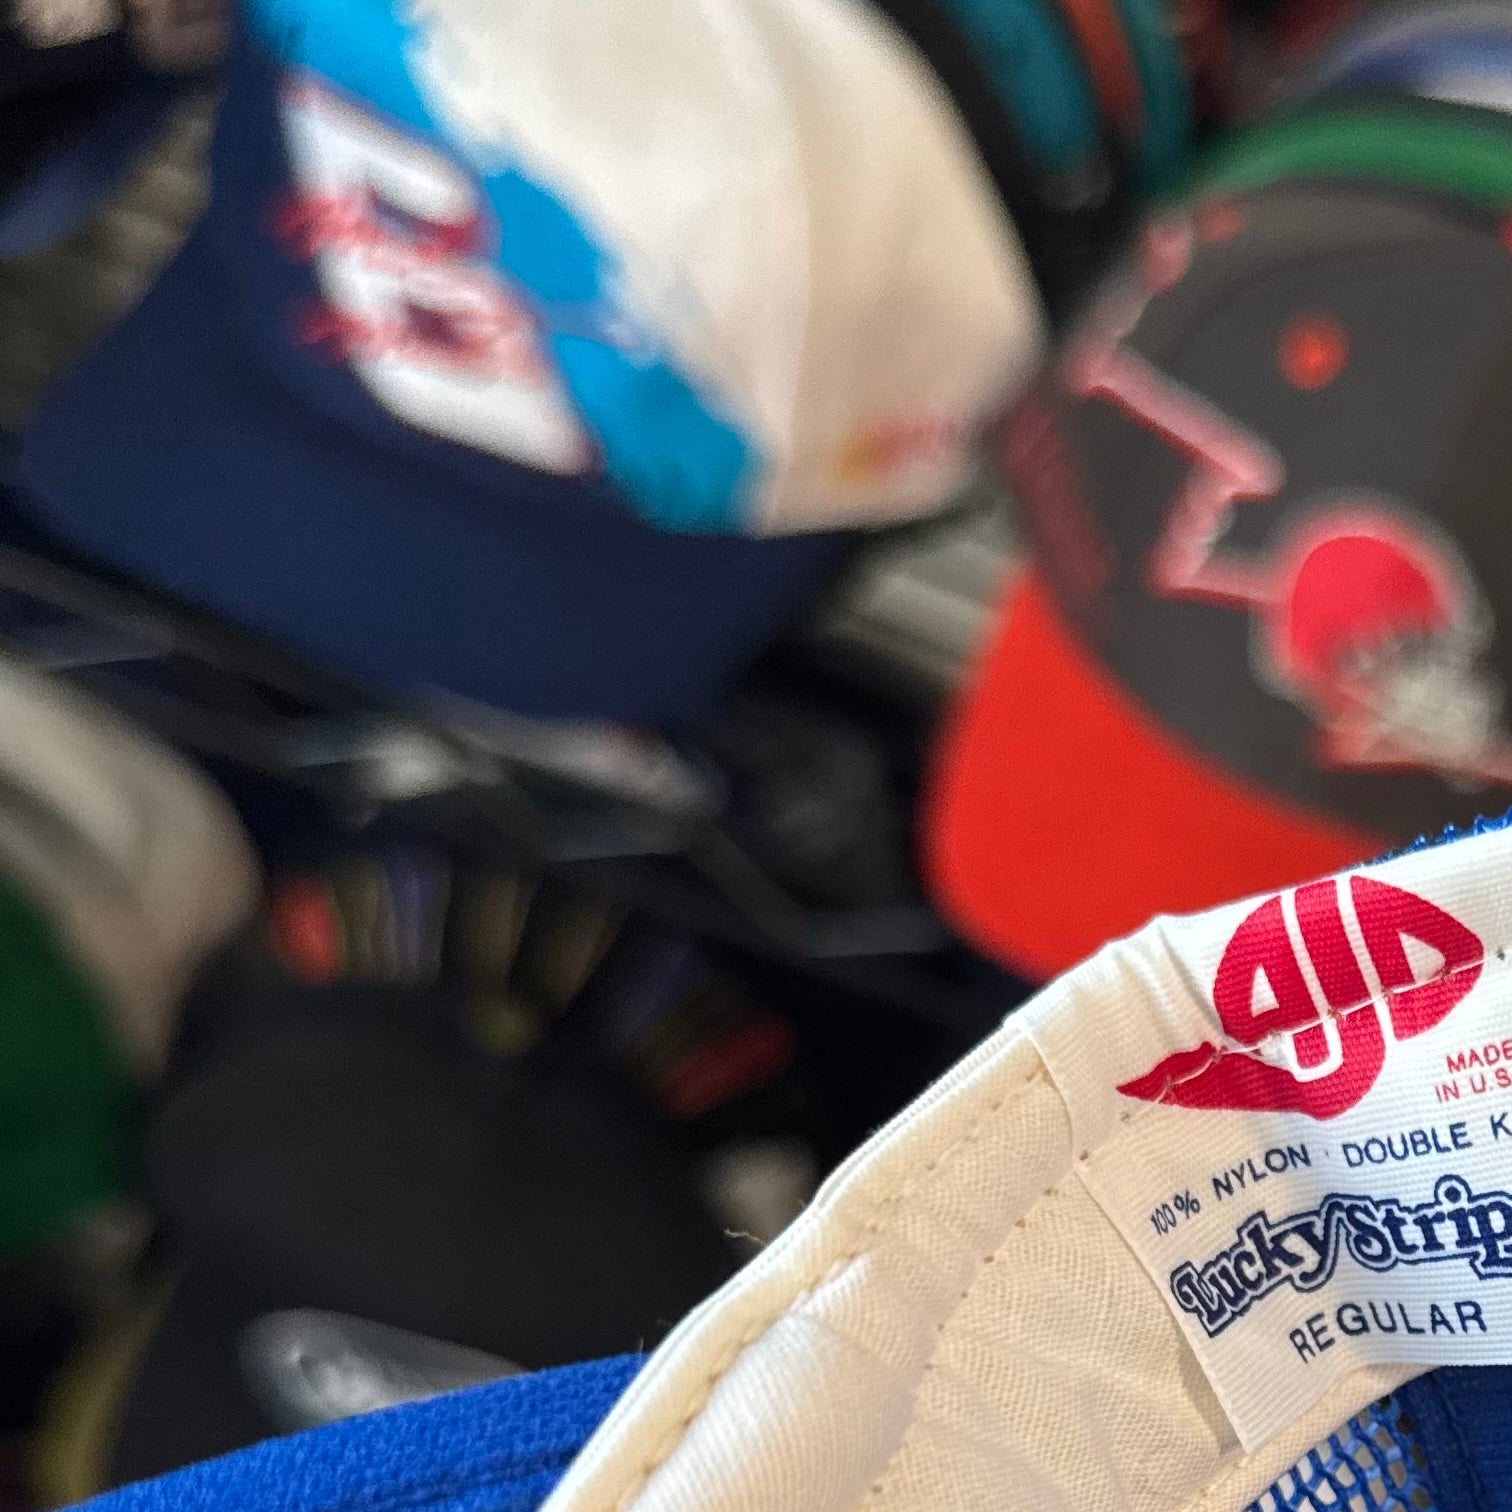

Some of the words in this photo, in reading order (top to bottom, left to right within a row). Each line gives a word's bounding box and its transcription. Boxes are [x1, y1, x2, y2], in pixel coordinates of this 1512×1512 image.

[1434, 1082, 1460, 1103] IN
[1212, 1143, 1311, 1201] NYLON
[1342, 1122, 1473, 1169] DOUBLE
[1170, 1193, 1346, 1339] Lucky
[1288, 1299, 1488, 1364] REGULAR
